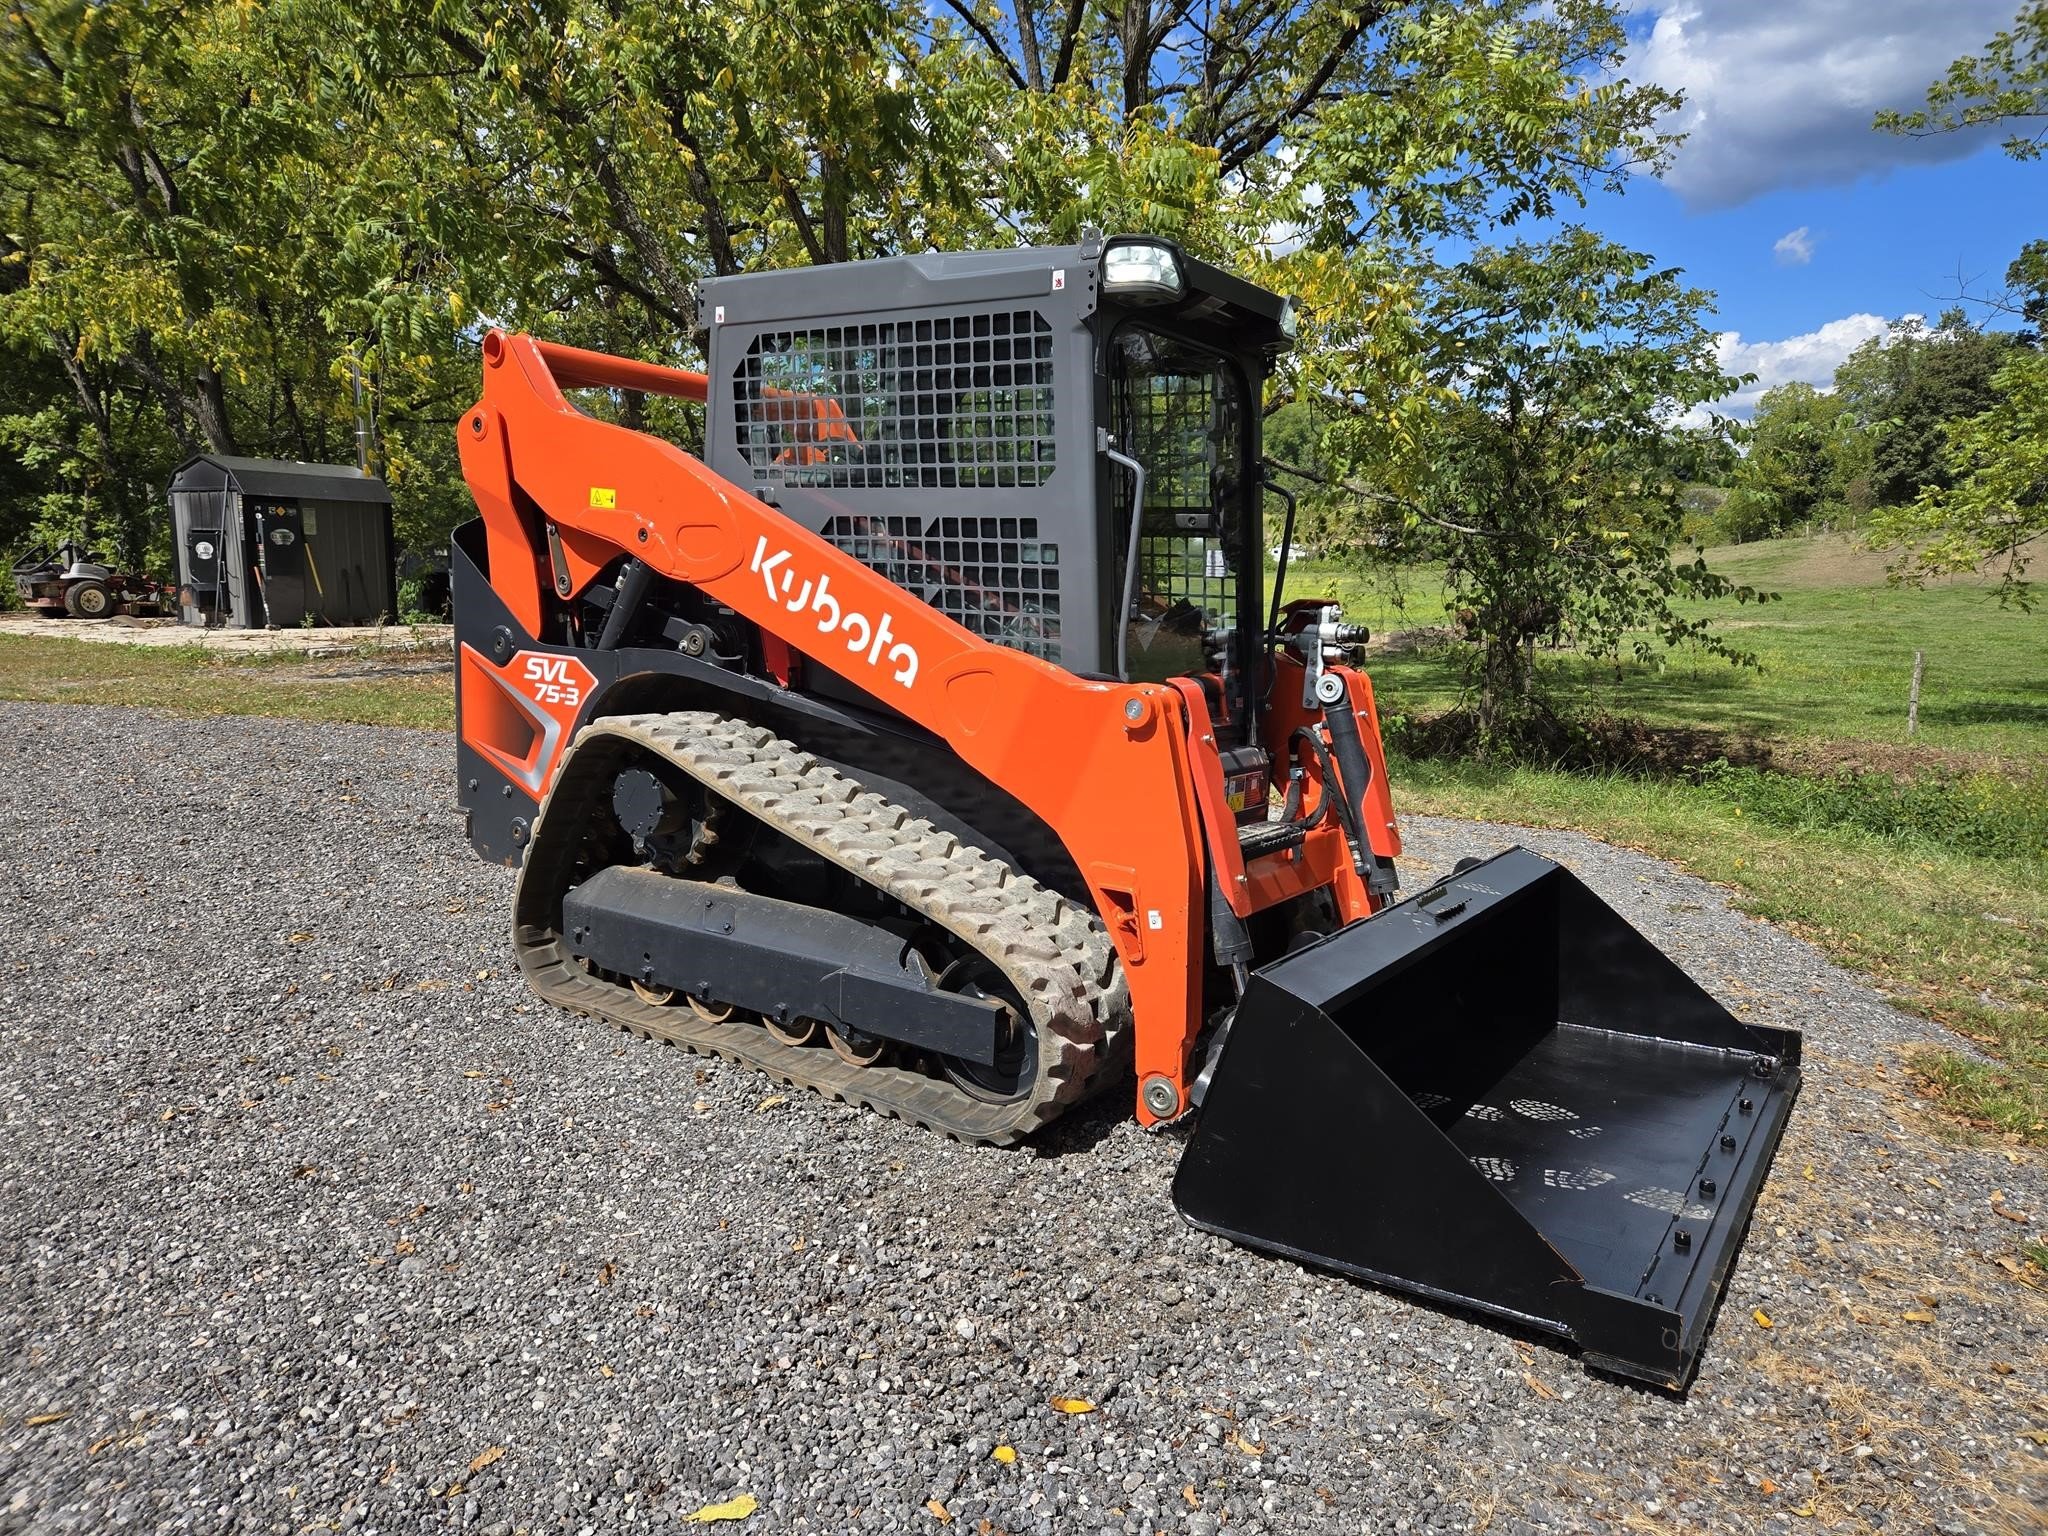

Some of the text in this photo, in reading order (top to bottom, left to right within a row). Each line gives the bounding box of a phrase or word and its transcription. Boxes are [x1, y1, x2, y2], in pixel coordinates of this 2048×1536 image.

[750, 535, 918, 689] Kubota
[523, 657, 576, 685] SVL
[534, 682, 579, 706] 75-3
